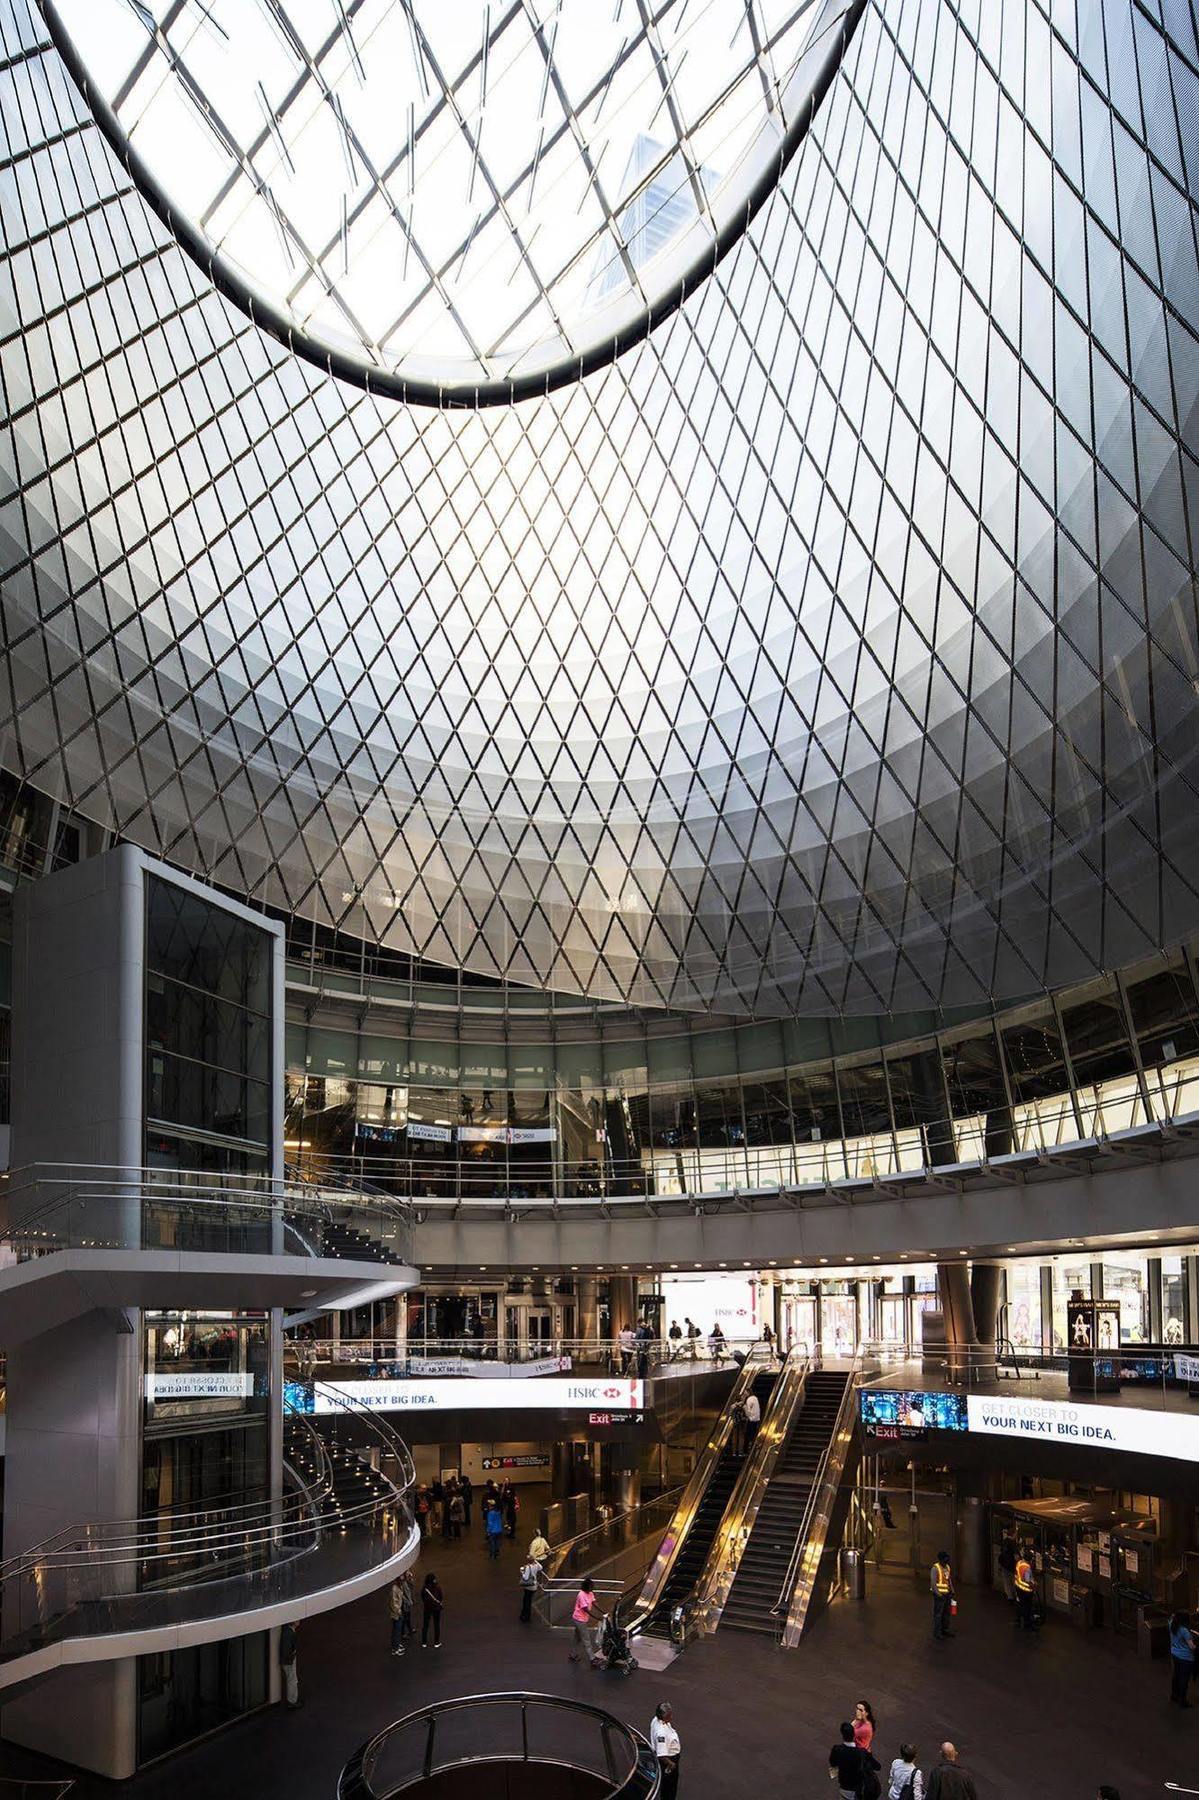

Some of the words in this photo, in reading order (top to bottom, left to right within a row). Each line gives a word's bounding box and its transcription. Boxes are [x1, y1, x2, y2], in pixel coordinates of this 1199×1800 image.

[568, 1387, 600, 1399] HSBC
[360, 1395, 388, 1406] NEXT
[391, 1395, 409, 1405] BIG
[411, 1394, 438, 1405] IDEA.
[982, 1402, 1005, 1416] GET
[1008, 1404, 1057, 1419] CLOSER
[1057, 1409, 1079, 1422] TO
[589, 1413, 610, 1424] Exit
[875, 1425, 898, 1438] Exit
[982, 1415, 1017, 1429] YOUR
[1020, 1418, 1053, 1433] NEXT
[1057, 1423, 1079, 1436] BIG
[1082, 1426, 1117, 1441] IDEA.
